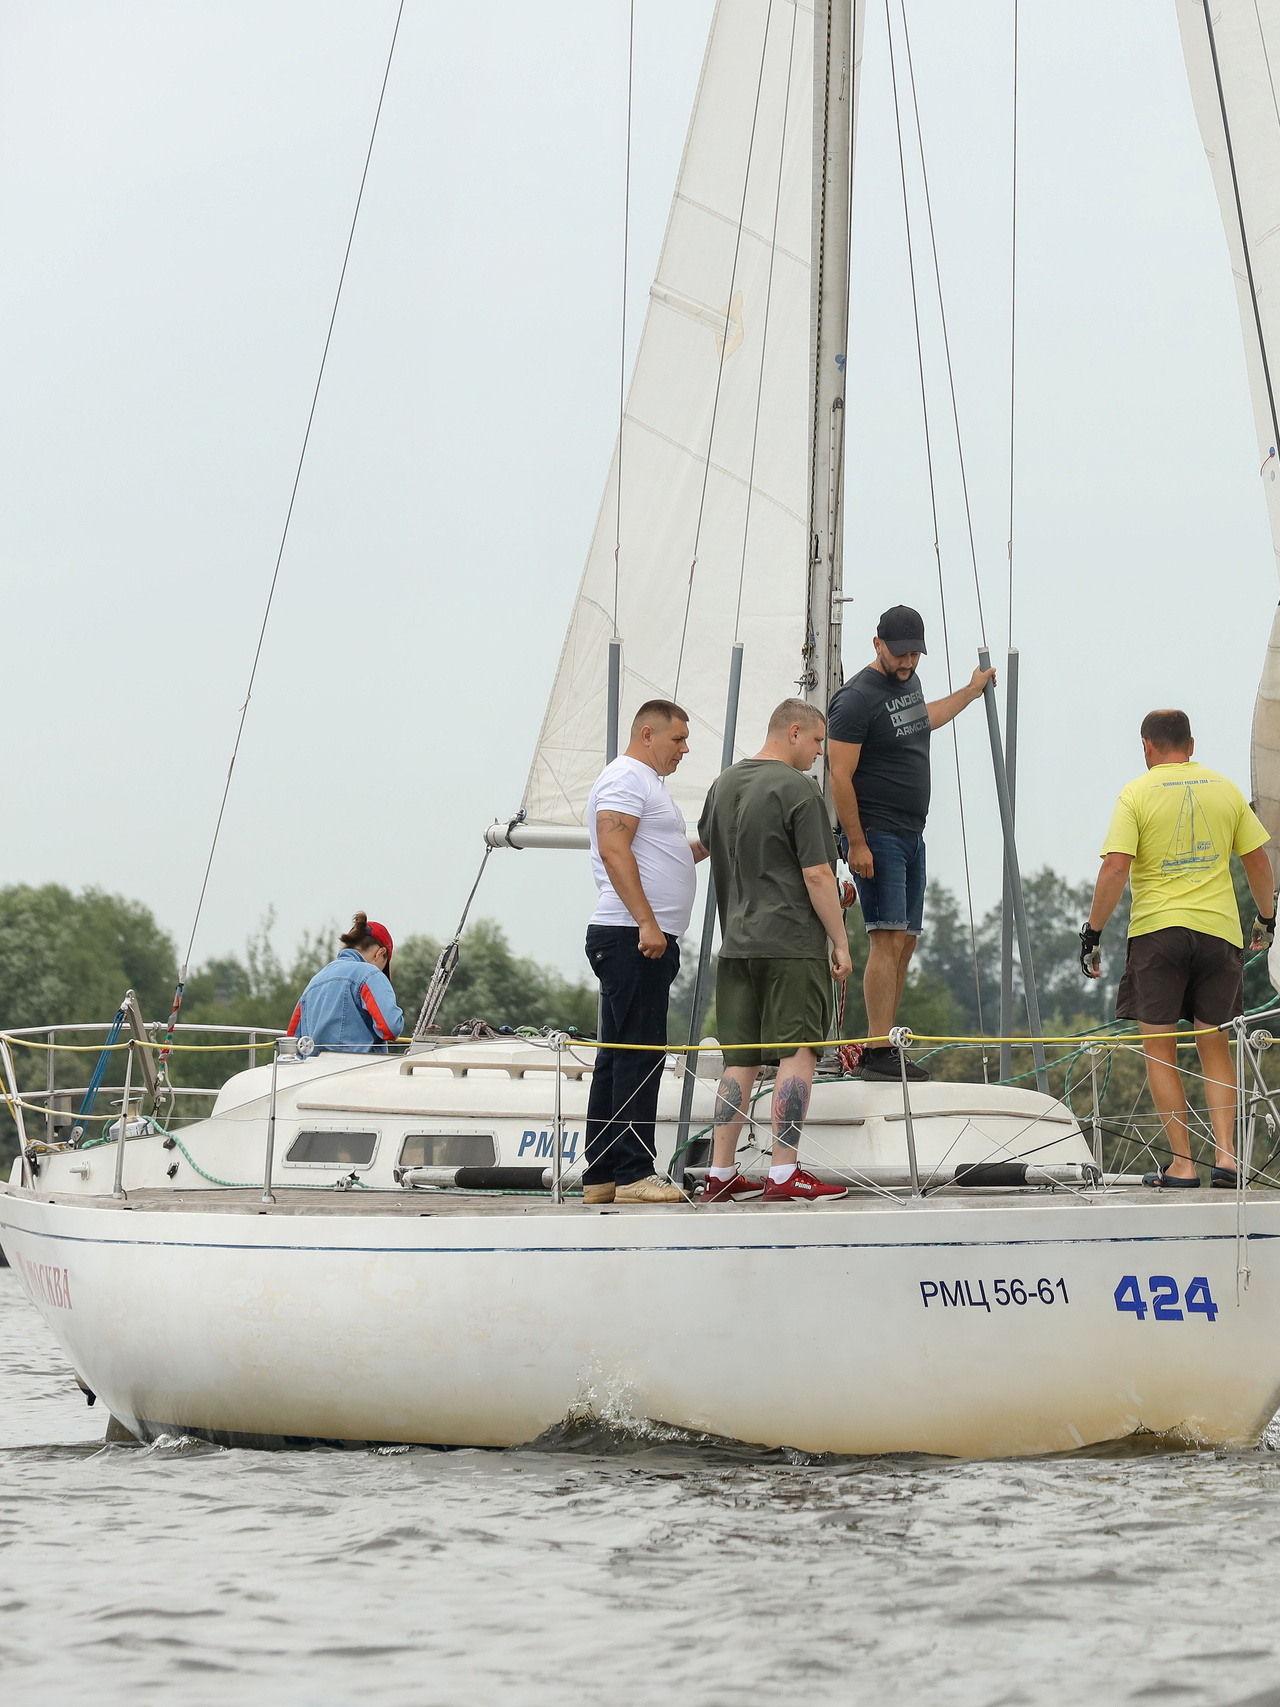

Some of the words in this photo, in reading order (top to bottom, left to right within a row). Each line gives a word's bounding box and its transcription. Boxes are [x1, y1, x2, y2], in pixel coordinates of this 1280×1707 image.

[518, 1130, 579, 1163] РМЦ
[26, 1260, 73, 1310] МОСКВА
[919, 1279, 992, 1313] РМЦ
[993, 1277, 1070, 1306] 56-61
[1113, 1274, 1219, 1322] 424
